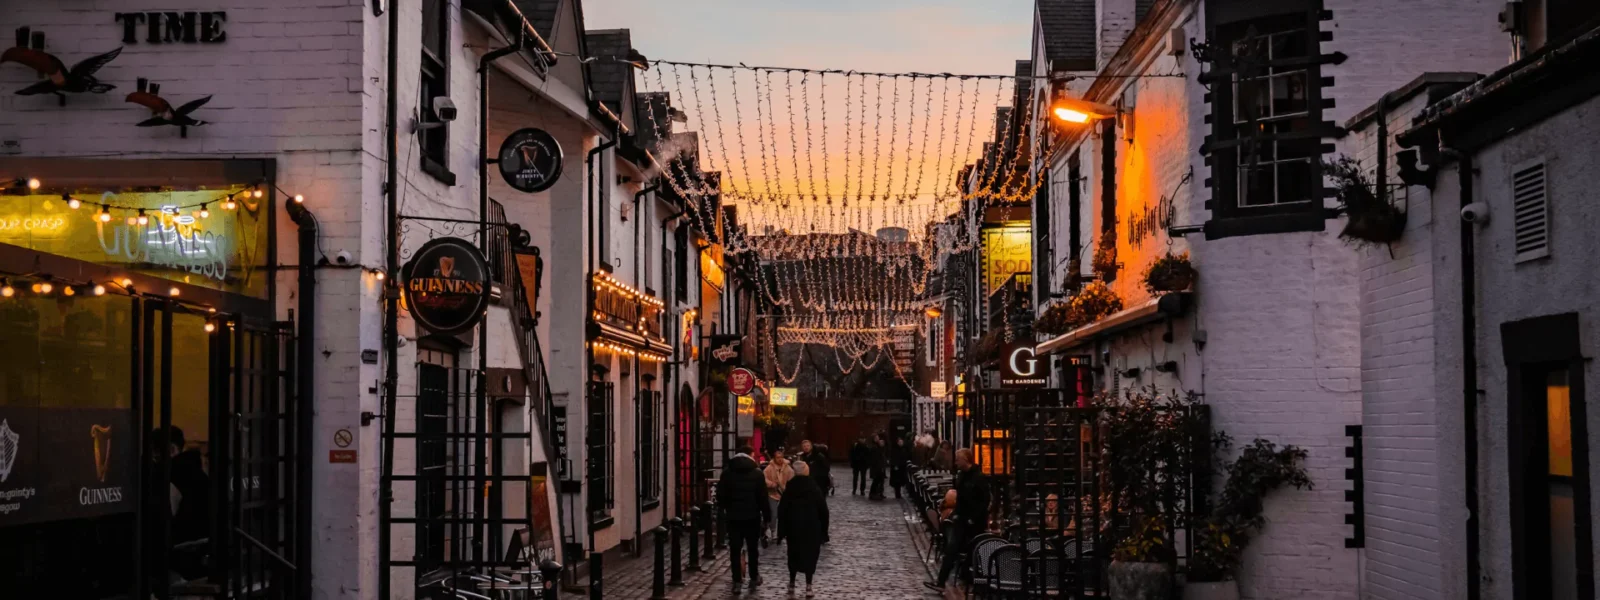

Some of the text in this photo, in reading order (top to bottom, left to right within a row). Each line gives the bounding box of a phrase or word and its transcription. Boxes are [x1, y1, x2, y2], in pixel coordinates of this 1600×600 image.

[115, 12, 227, 43] TIME
[409, 277, 484, 295] GUINNESS
[1009, 346, 1038, 377] G
[79, 486, 123, 505] GUINNESS
